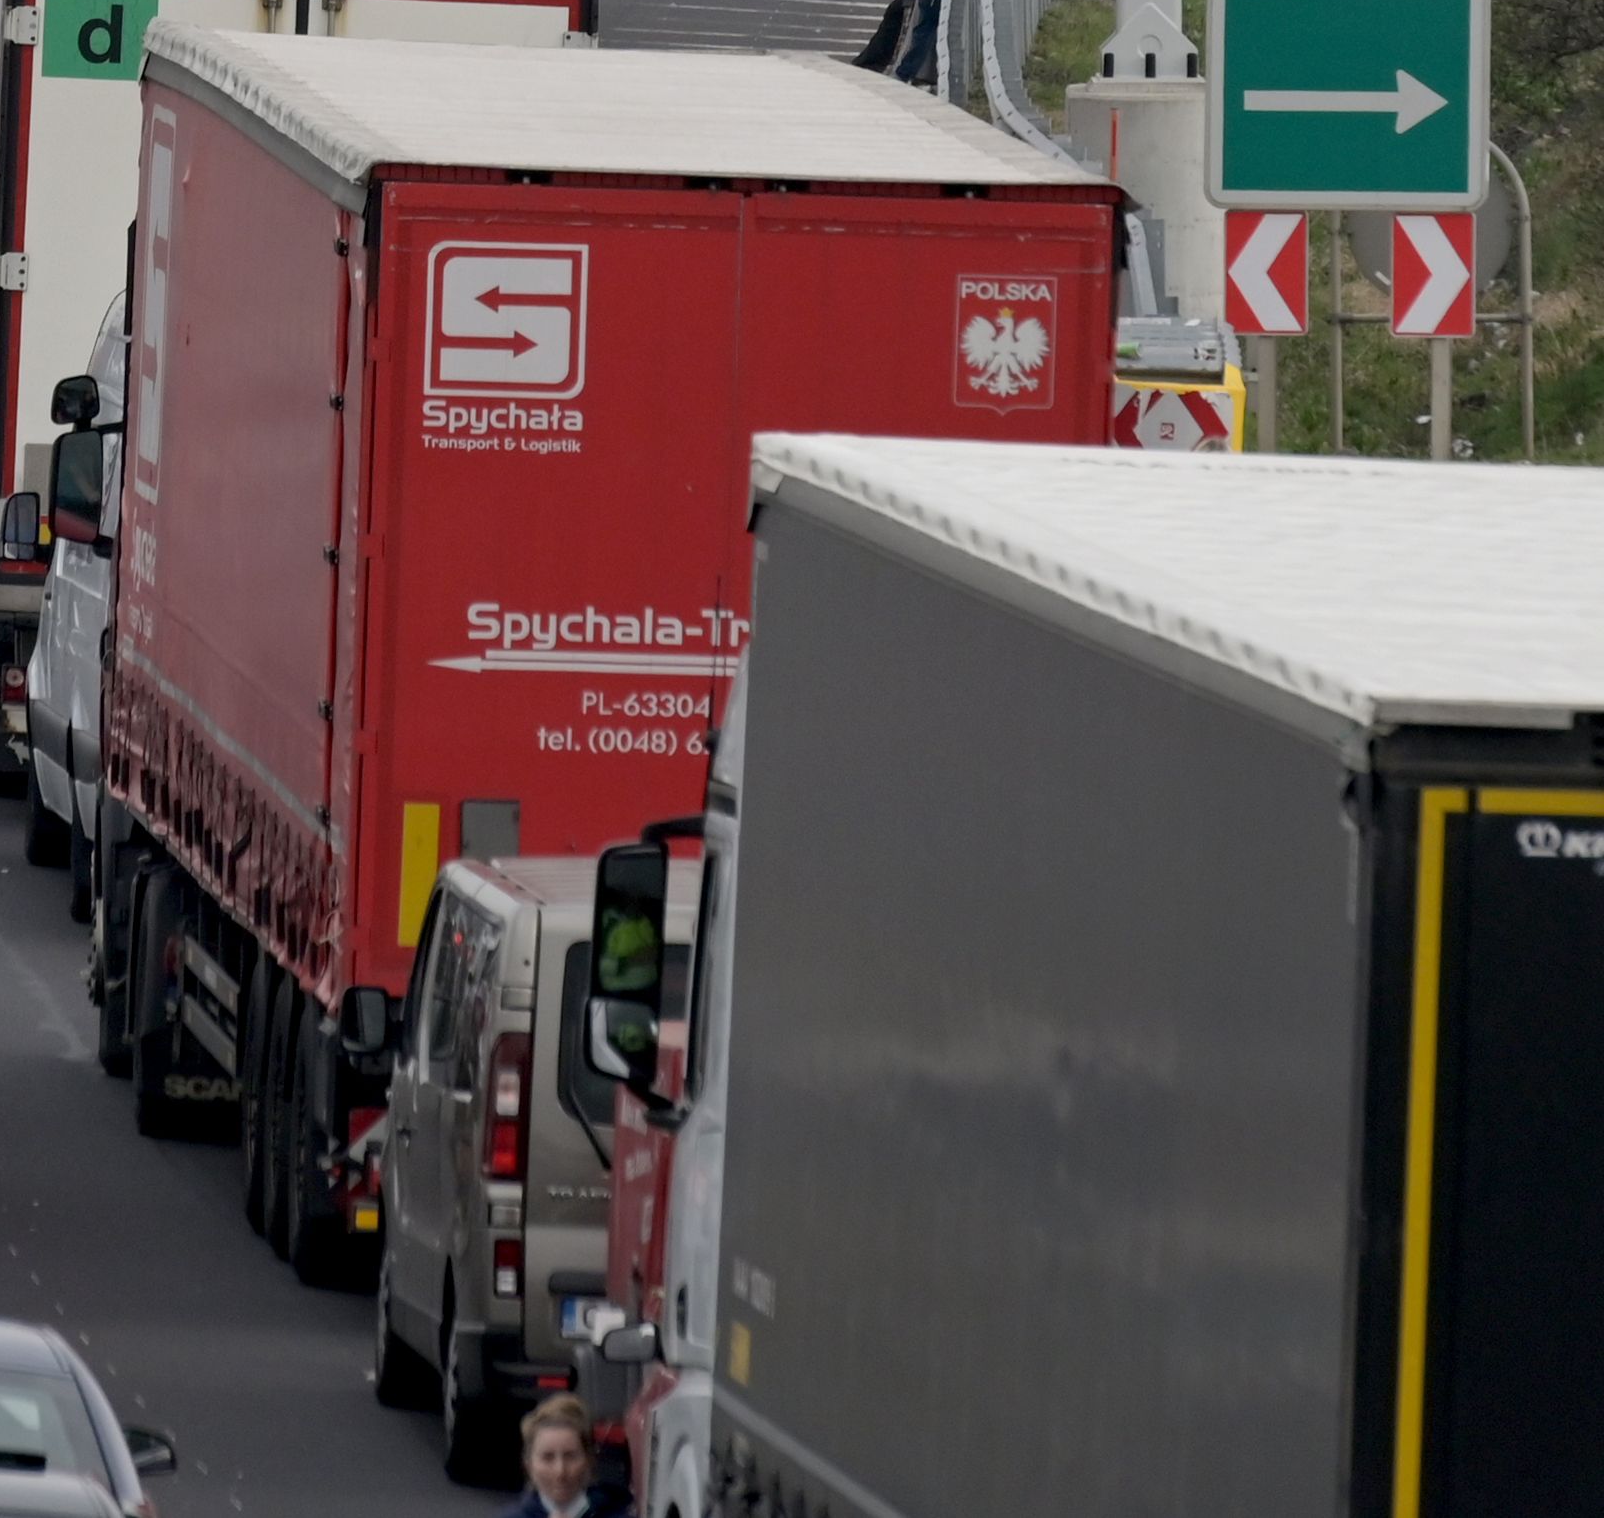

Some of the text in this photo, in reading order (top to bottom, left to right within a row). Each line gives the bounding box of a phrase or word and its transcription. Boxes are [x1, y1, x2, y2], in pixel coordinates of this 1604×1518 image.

[77, 4, 123, 65] d
[961, 281, 1052, 302] POLSKA
[422, 400, 584, 434] Spychała
[422, 435, 582, 455] Transport & Logistik
[466, 601, 750, 651] Spychala-Tr
[581, 691, 711, 719] PL-63304
[537, 725, 711, 756] tel. (0048) 6
